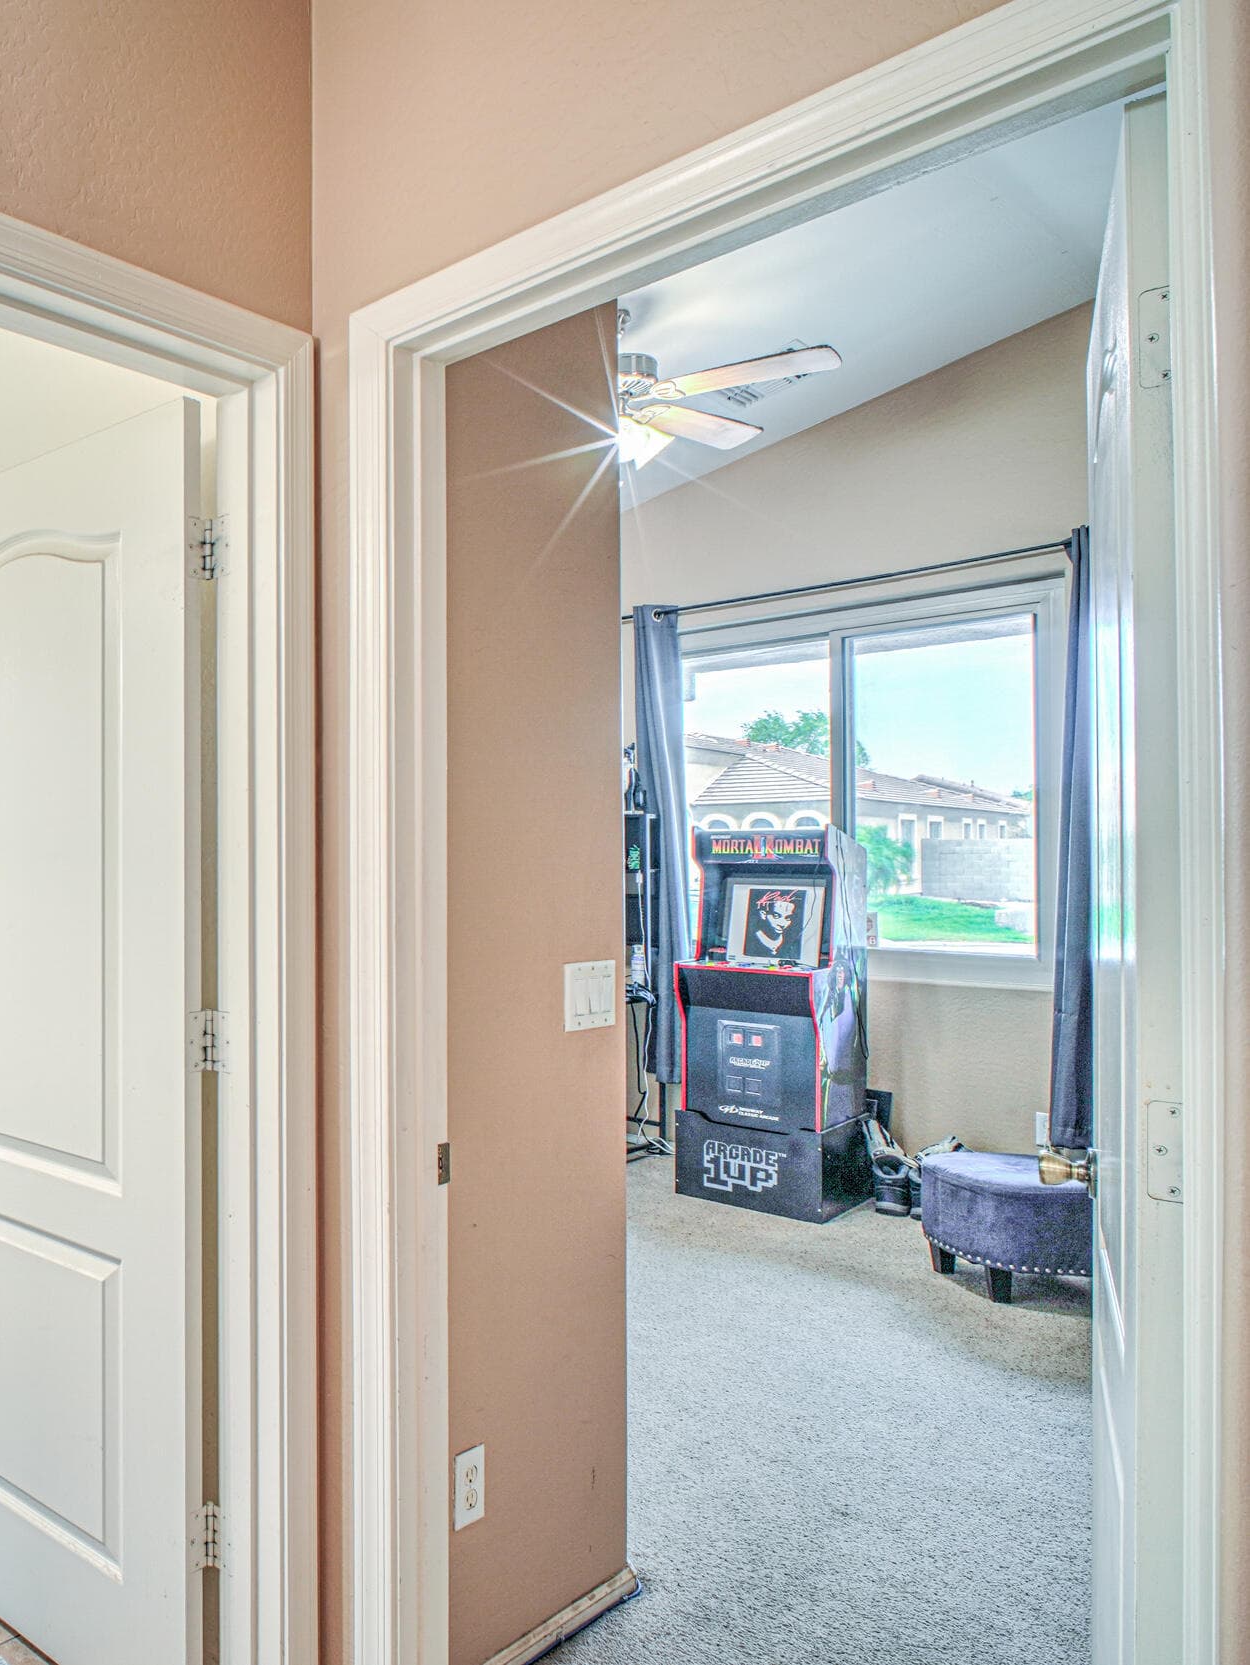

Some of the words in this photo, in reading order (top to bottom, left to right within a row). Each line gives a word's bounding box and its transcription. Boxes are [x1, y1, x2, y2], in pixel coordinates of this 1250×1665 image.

[712, 839, 761, 854] MORTAL
[765, 839, 821, 855] KOMBAT
[704, 1140, 778, 1170] ARCADE
[704, 1156, 778, 1192] 1UP
